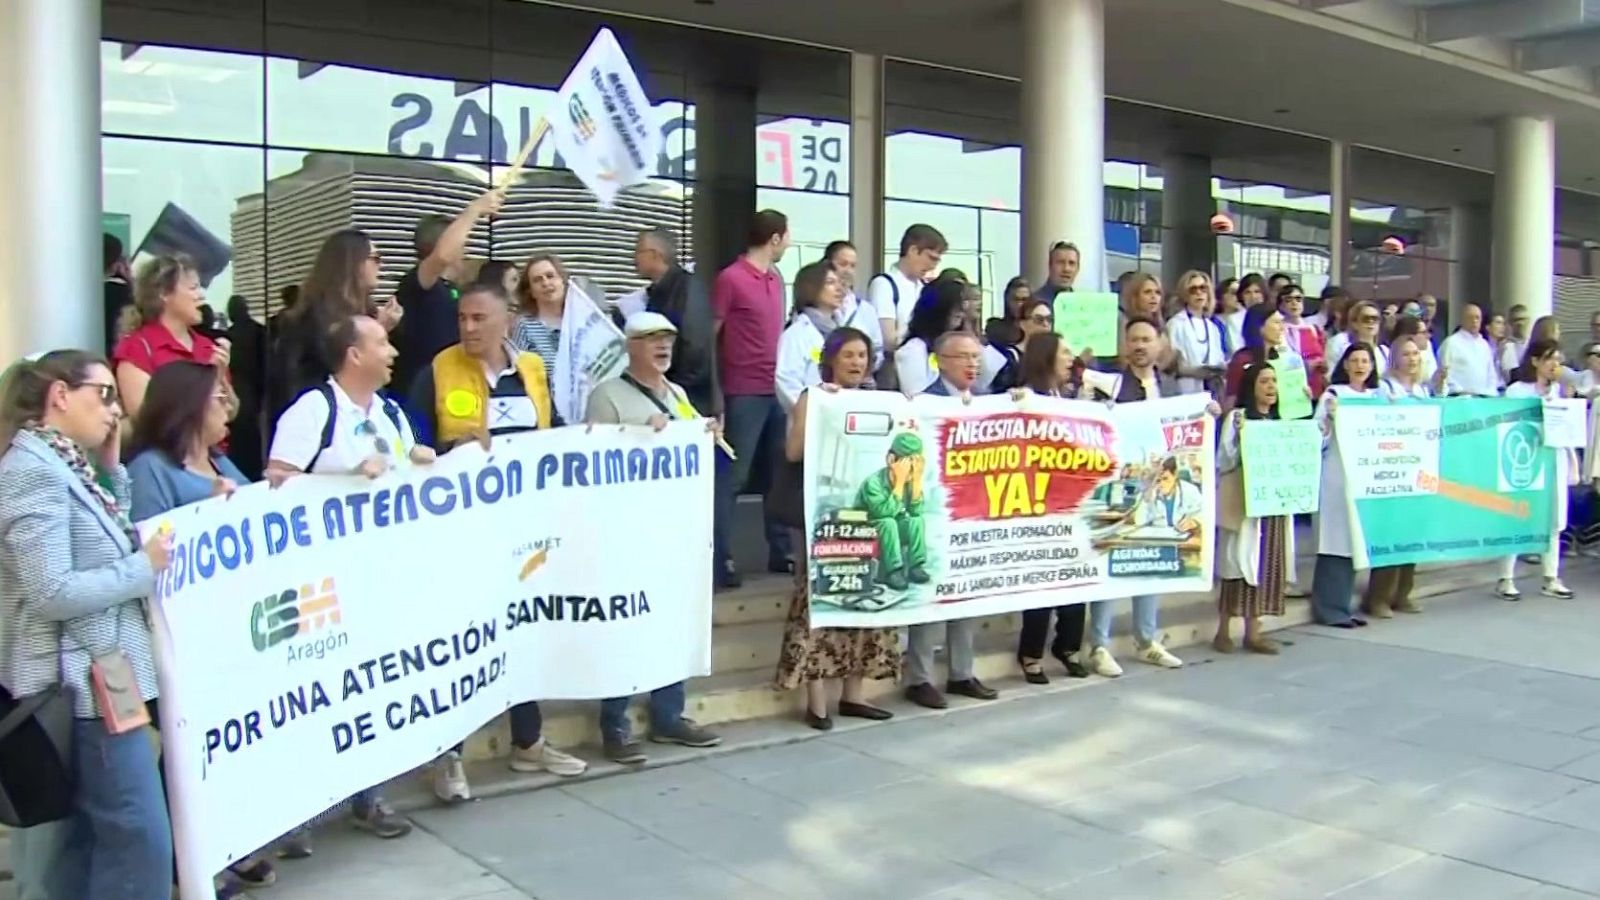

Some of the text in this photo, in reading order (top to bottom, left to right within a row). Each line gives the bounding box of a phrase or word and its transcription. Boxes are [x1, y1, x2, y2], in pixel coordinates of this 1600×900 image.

[946, 417, 1105, 448] ¡NECESITAMOS UN
[945, 445, 1111, 476] ESTATUTO PROPIO
[263, 505, 311, 555] DE
[322, 455, 522, 539] ATENCIÓN
[536, 443, 699, 490] PRIMARIA
[984, 472, 1051, 518] YA!
[950, 522, 1073, 546] POR NUESTRA FORMACIÓN
[950, 555, 987, 570] MÁXIMA
[1111, 547, 1160, 560] AGENDAS
[1111, 560, 1179, 574] DESBORDADAS
[829, 575, 863, 592] 24h
[936, 583, 956, 596] POR
[957, 582, 968, 594] LA
[1058, 563, 1098, 581] ESPAÑA
[269, 680, 331, 729] UNA
[342, 619, 497, 702] ATENCIÓN
[505, 590, 651, 630] SANITARIA
[287, 630, 348, 666] Aragón
[332, 651, 506, 754] DE CALIDAD!
